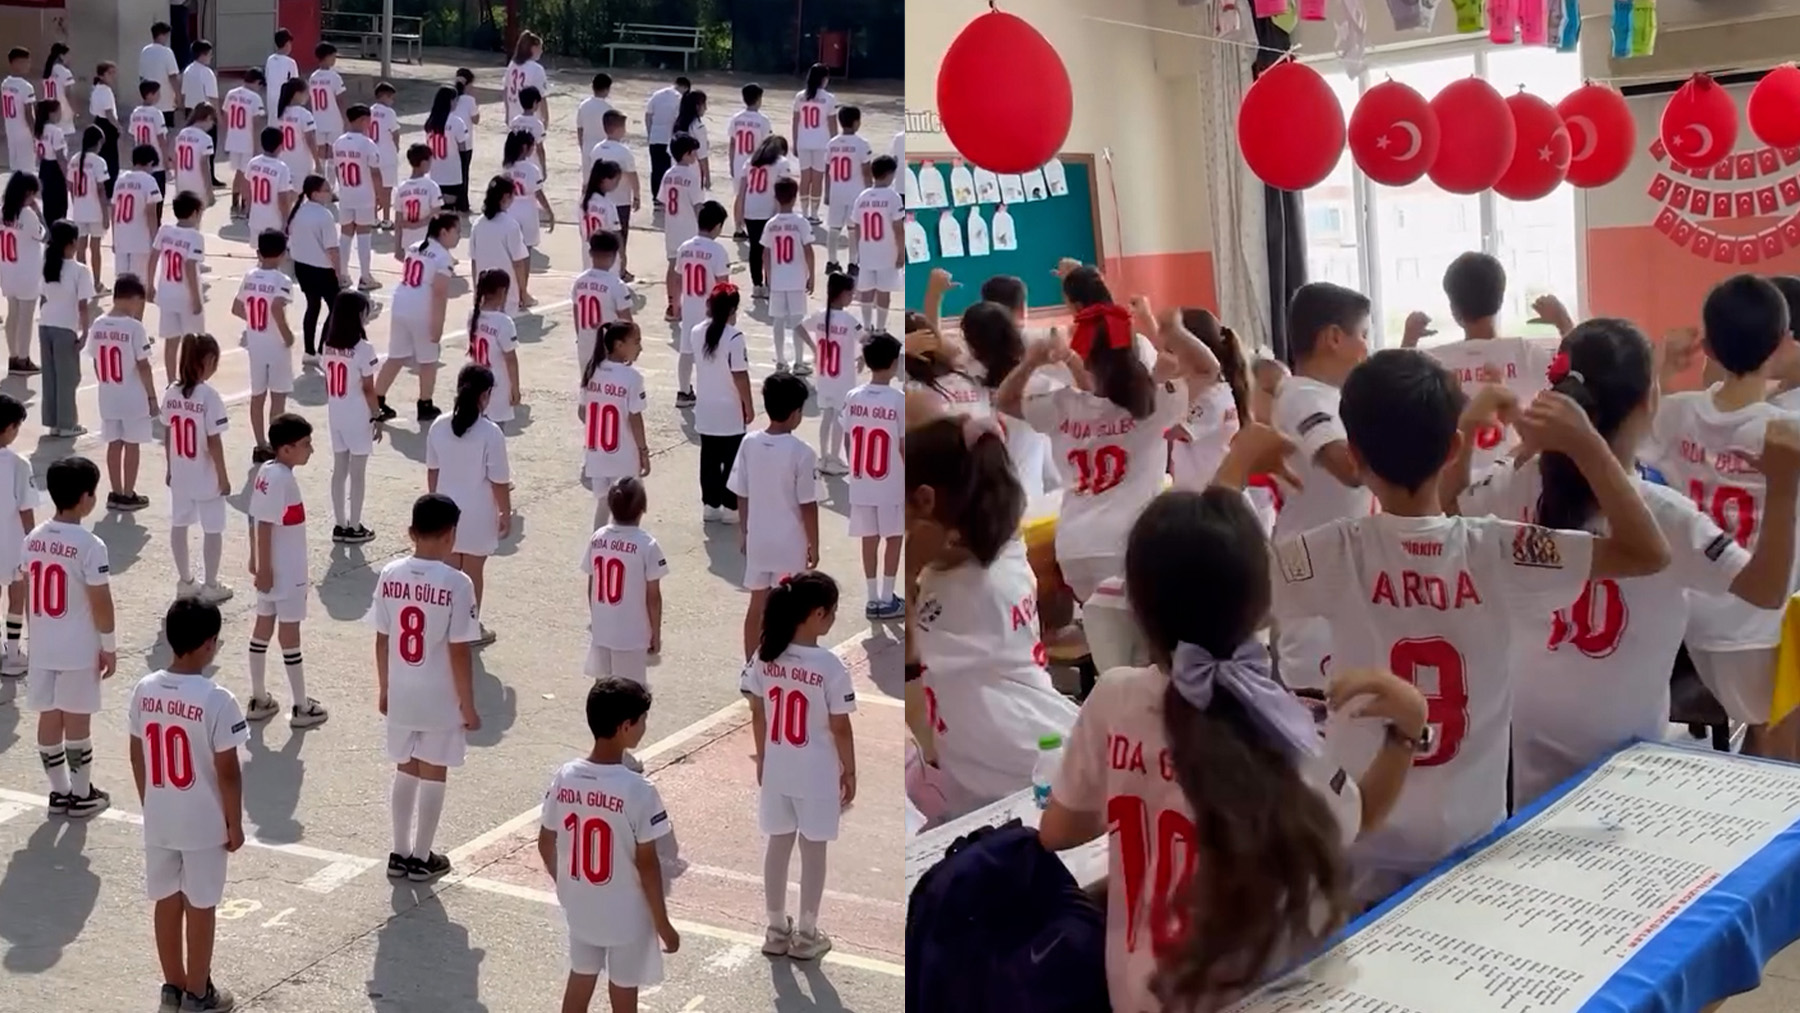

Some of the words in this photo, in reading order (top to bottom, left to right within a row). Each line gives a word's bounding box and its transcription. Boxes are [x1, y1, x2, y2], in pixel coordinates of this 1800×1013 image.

[3, 95, 17, 118] 10
[313, 89, 328, 111] 10
[230, 105, 246, 129] 10
[802, 106, 820, 129] 10
[735, 130, 754, 154] 10
[178, 146, 193, 171] 10
[831, 156, 851, 182] 10
[252, 175, 271, 205] 10
[339, 162, 361, 188] 10
[116, 194, 134, 224] 10
[405, 199, 420, 223] 10
[668, 187, 678, 216] 8
[864, 211, 884, 242] 10
[0, 230, 18, 263] 10
[775, 235, 794, 264] 10
[165, 249, 183, 282] 10
[403, 257, 424, 289] 10
[684, 263, 706, 296] 10
[247, 296, 268, 332] 10
[578, 295, 602, 330] 10
[99, 346, 123, 384] 10
[327, 361, 348, 398] 10
[171, 415, 198, 460] 10
[588, 402, 619, 453] 10
[852, 426, 890, 480] 10
[1067, 446, 1126, 495] 10
[50, 541, 78, 559] GÜLER
[611, 540, 638, 555] GÜLER
[30, 561, 68, 619] 10
[594, 556, 625, 606] 10
[1371, 570, 1482, 611] ARDA
[400, 606, 426, 667] 8
[791, 667, 824, 688] GÜLER
[141, 697, 163, 714] RDA
[167, 699, 204, 723] GÜLER
[768, 685, 810, 748] 10
[145, 723, 196, 790] 10
[588, 791, 625, 814] GÜLER
[564, 812, 614, 885] 10
